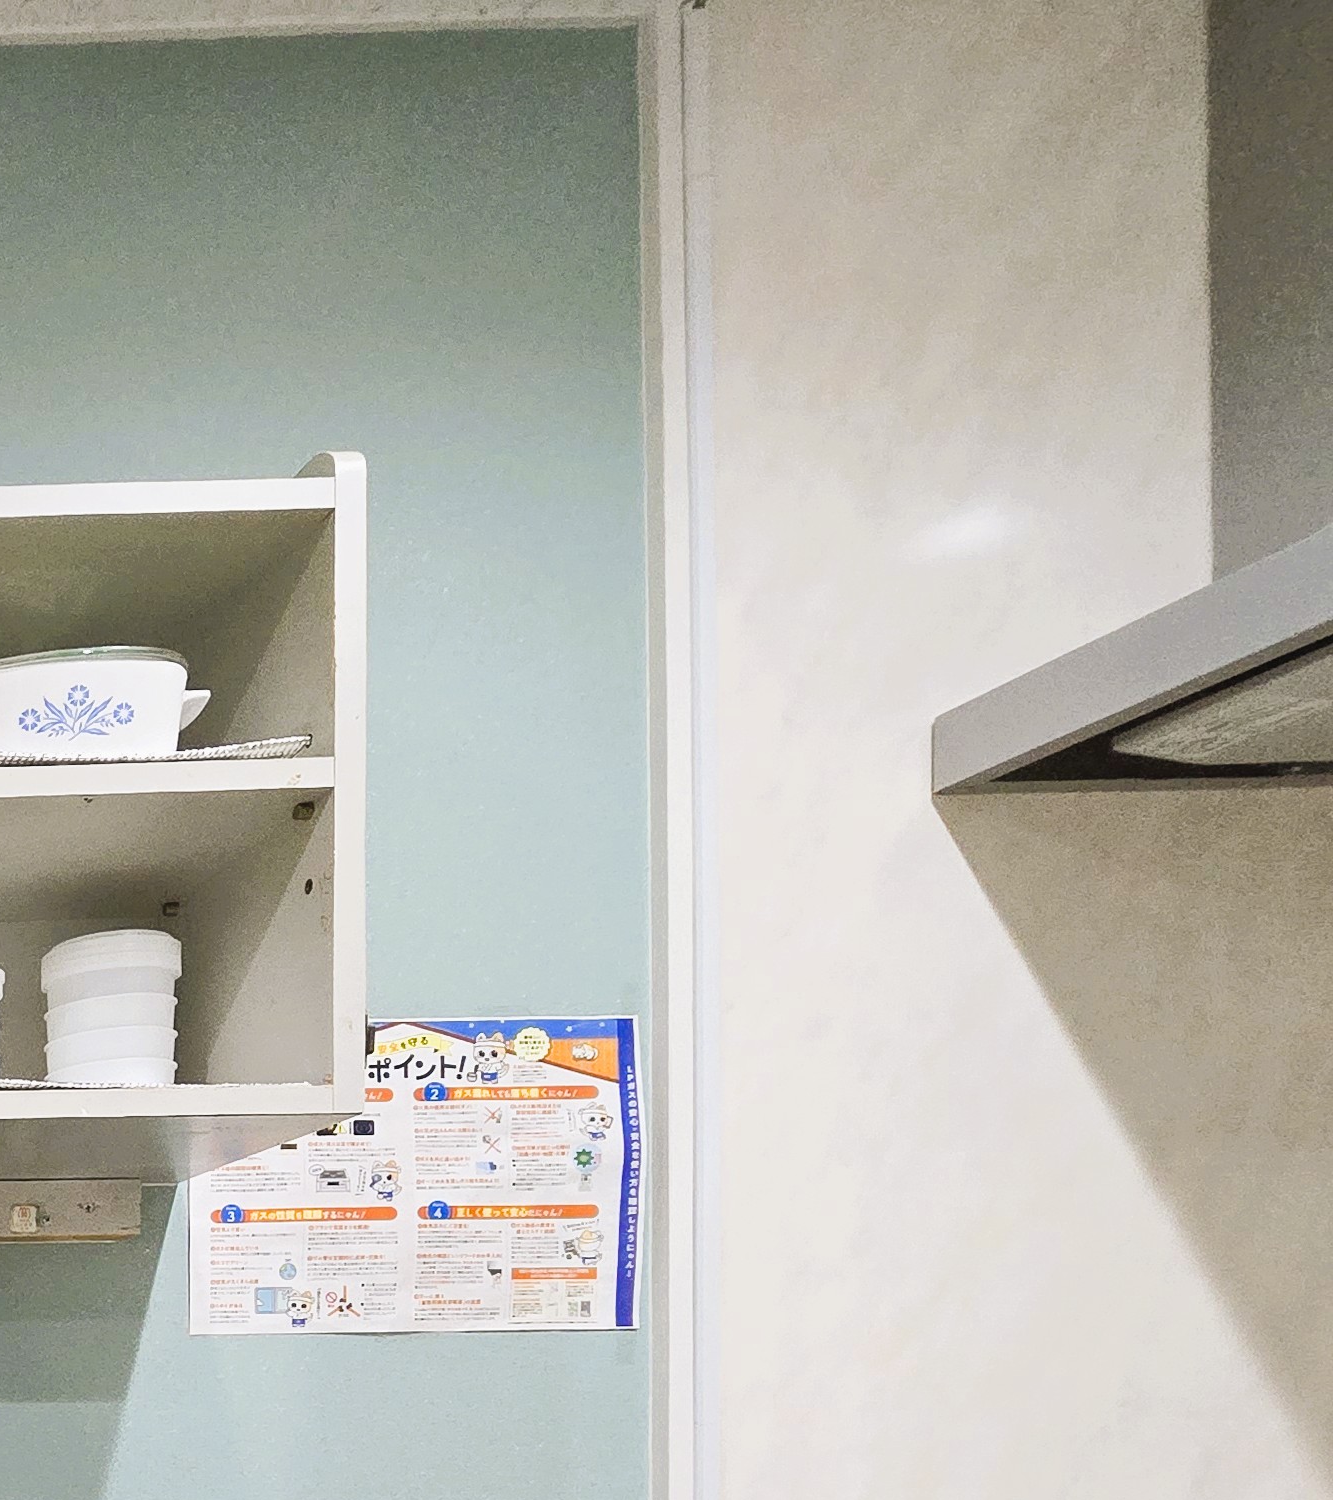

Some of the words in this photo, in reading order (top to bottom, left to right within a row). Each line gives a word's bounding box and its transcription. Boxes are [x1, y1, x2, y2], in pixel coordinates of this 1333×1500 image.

[377, 1035, 429, 1055] 安全を守る
[430, 1088, 439, 1100] 2
[226, 1211, 236, 1223] 3
[433, 1207, 442, 1219] 4
